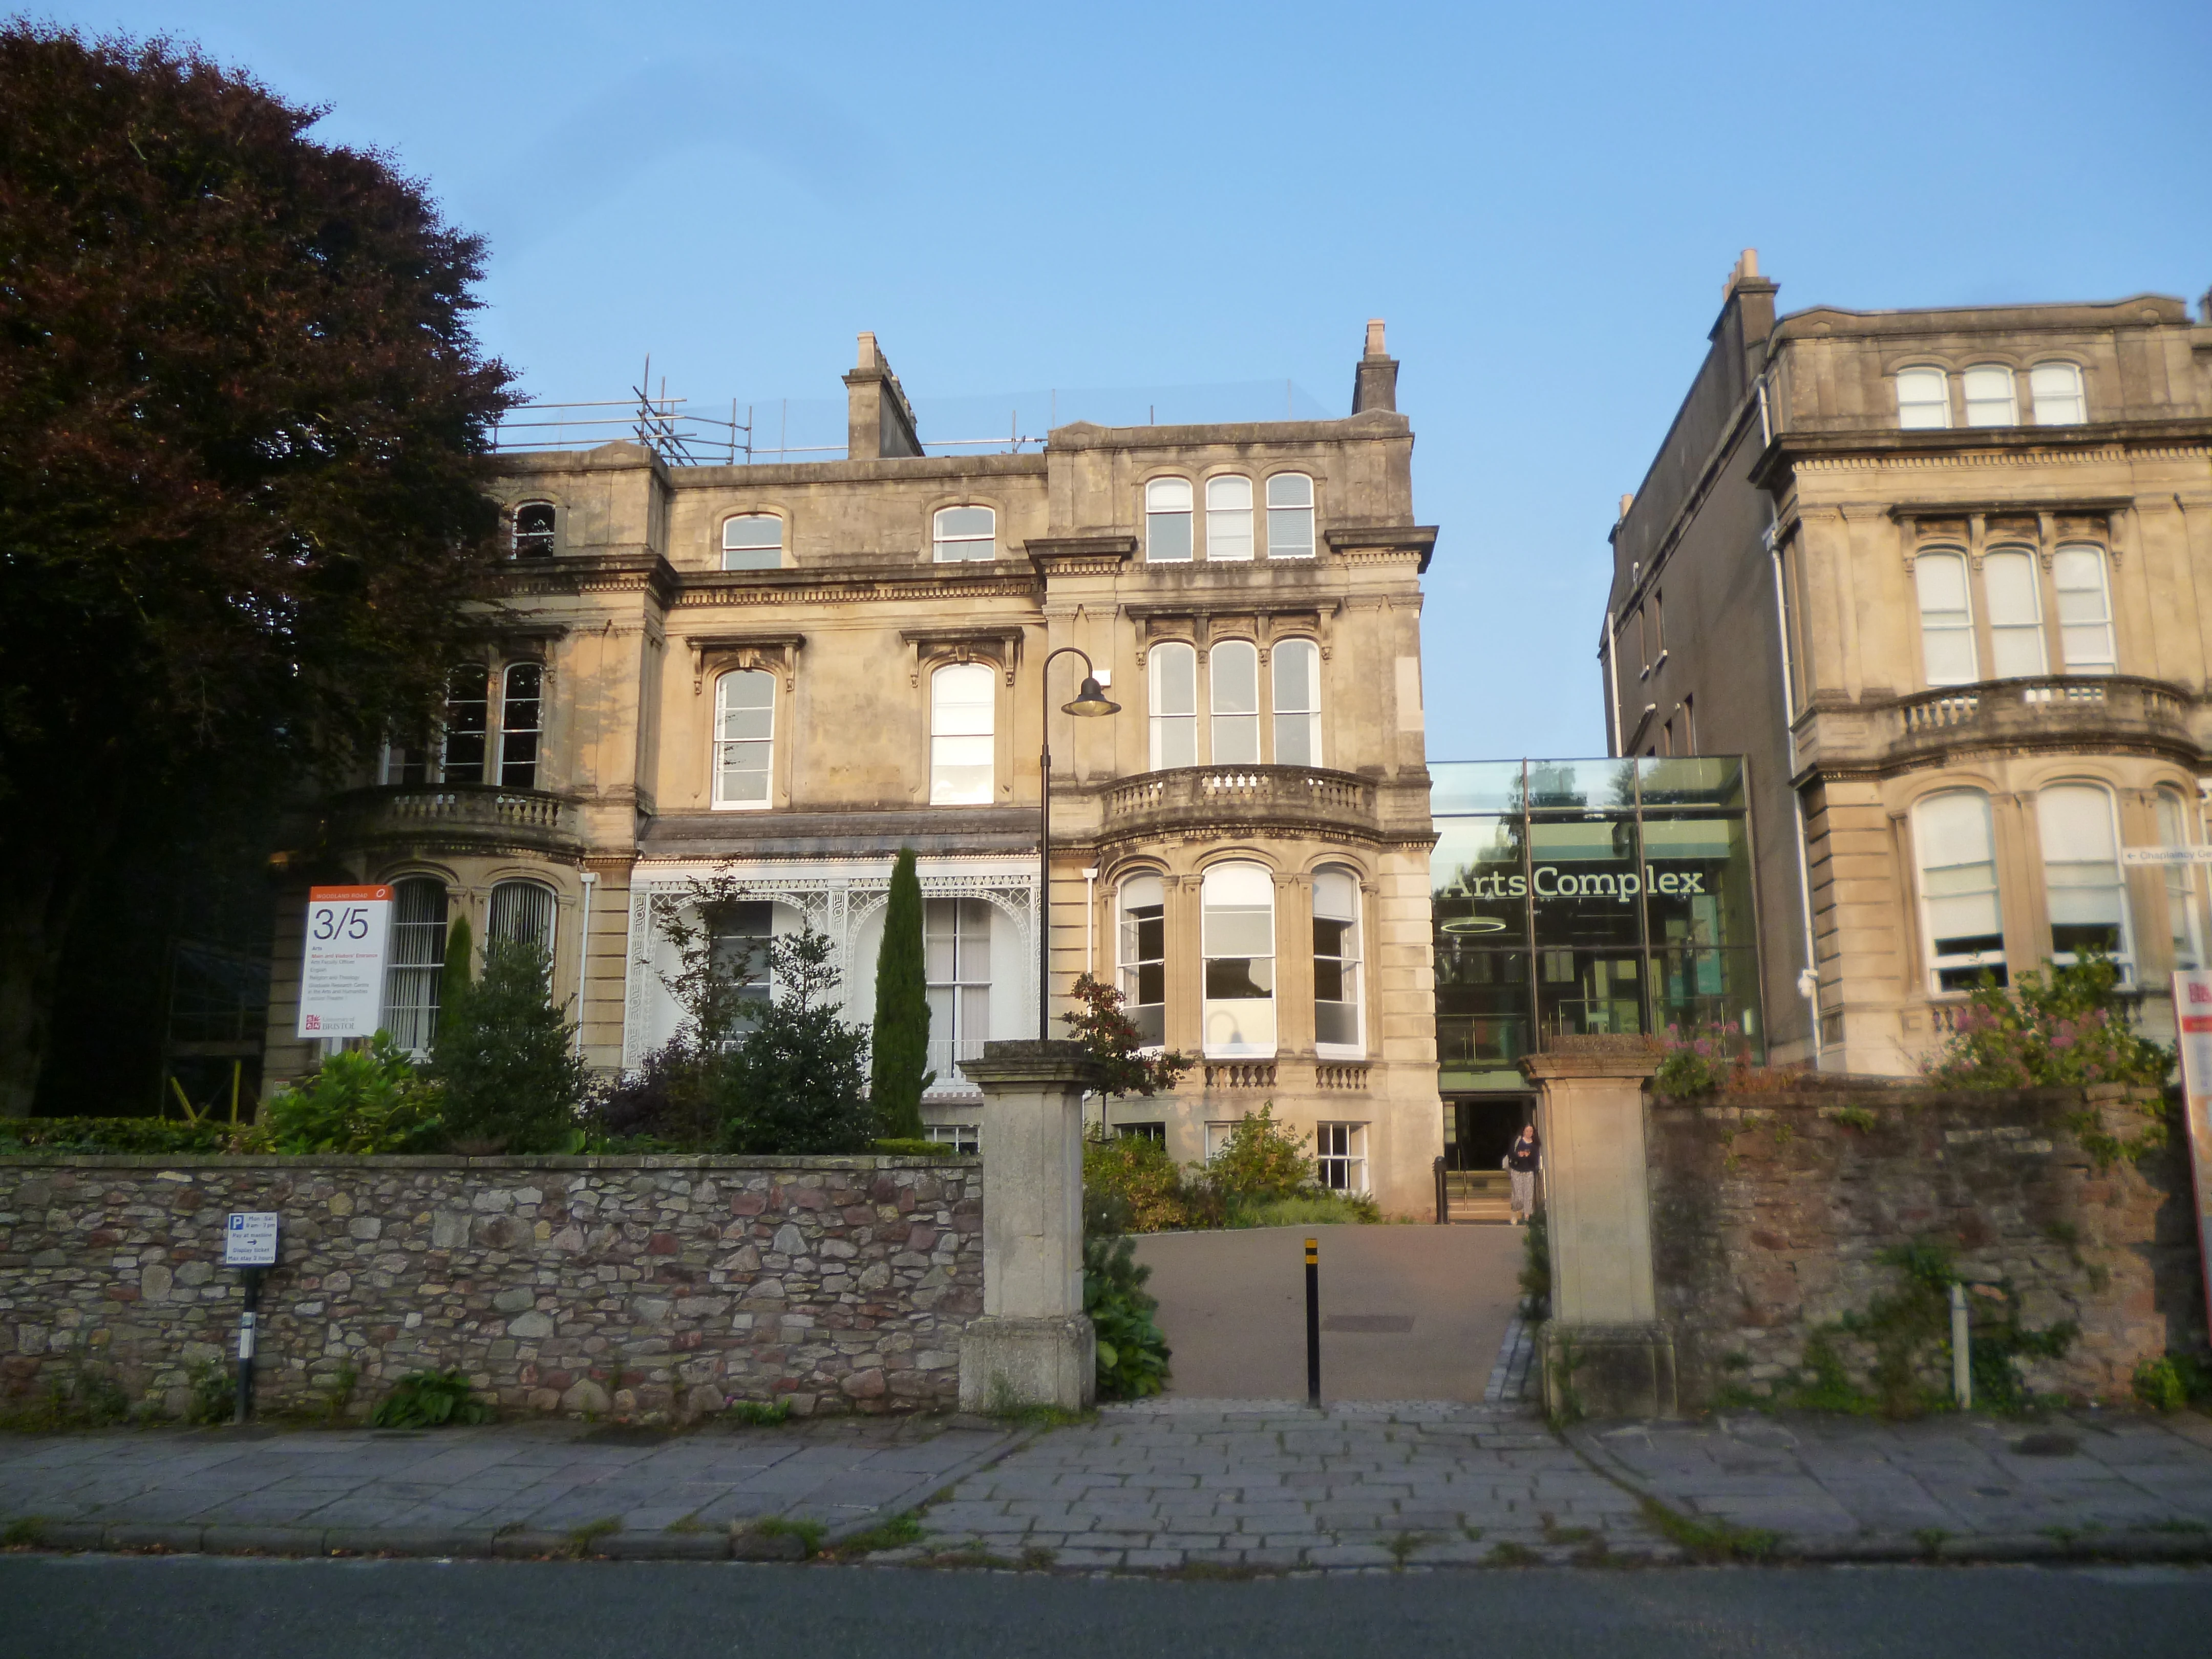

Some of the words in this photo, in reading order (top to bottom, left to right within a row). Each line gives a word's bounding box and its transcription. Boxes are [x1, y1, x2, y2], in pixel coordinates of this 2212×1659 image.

[1442, 871, 1527, 898] Arts
[1533, 865, 1705, 903] Complex
[314, 907, 369, 940] 3/5
[233, 1216, 242, 1229] P
